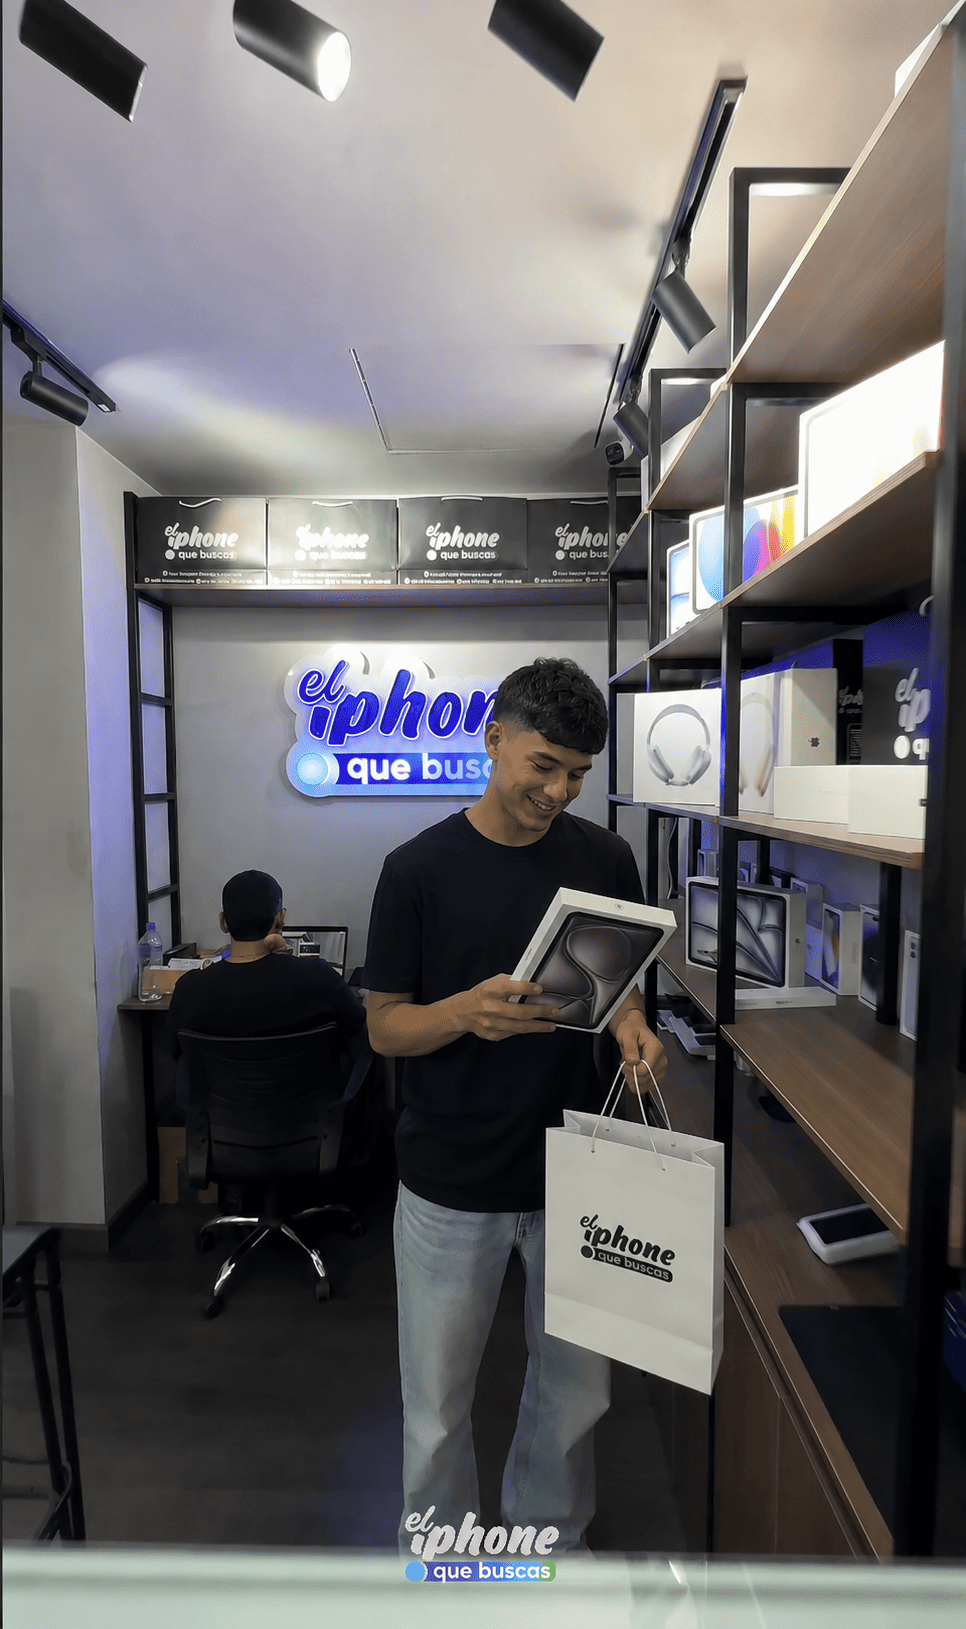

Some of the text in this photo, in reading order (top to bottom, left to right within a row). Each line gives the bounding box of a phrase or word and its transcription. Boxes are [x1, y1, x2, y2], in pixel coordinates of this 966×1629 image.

[165, 522, 180, 537] el
[168, 526, 239, 550] iphone
[425, 522, 441, 537] el
[429, 525, 500, 550] iphone
[555, 523, 570, 537] el
[178, 550, 235, 560] que buscas
[440, 550, 496, 561] que buscas
[569, 551, 588, 560] que
[298, 659, 347, 704] el
[309, 669, 499, 747] iphon
[347, 757, 411, 785] que
[580, 1214, 598, 1230] el
[584, 1224, 676, 1266] iphone
[598, 1252, 669, 1280] que buscas
